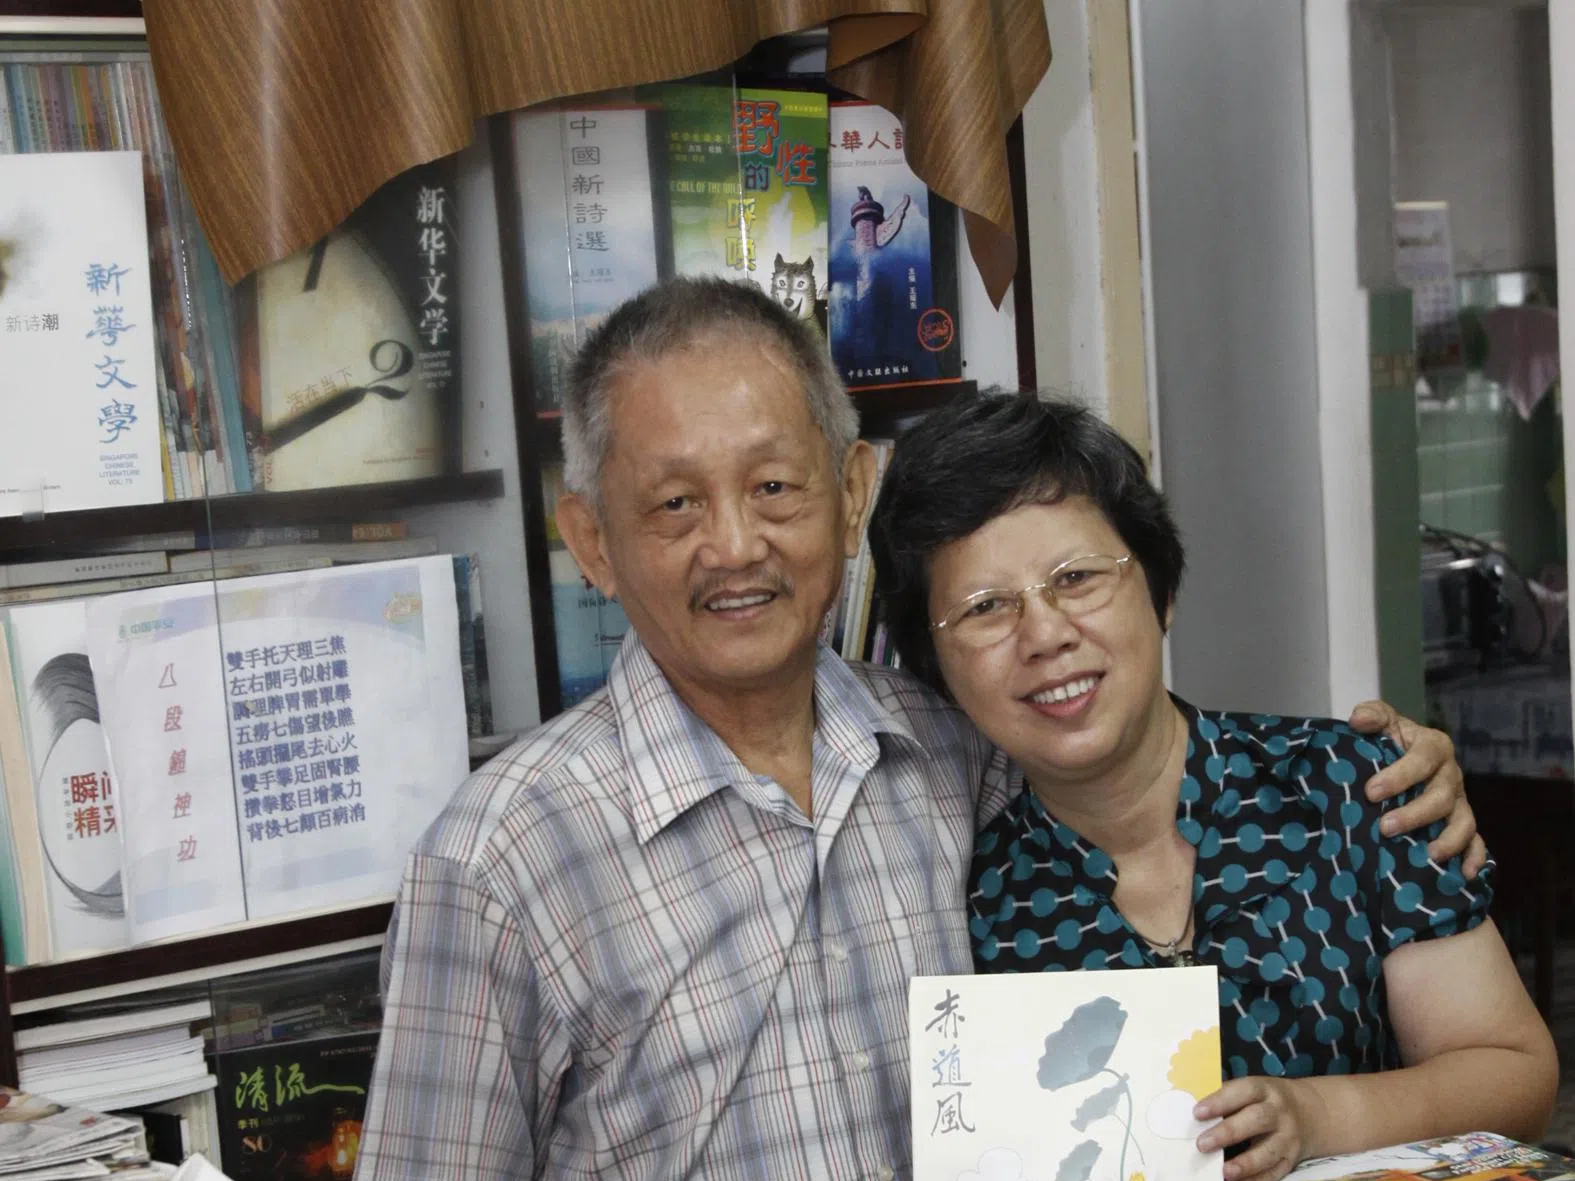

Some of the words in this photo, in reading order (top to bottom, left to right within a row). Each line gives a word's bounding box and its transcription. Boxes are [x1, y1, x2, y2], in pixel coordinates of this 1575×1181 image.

[570, 116, 610, 252] 中國新詩選
[829, 128, 903, 153] 華人
[416, 185, 450, 345] 新华文学
[6, 312, 59, 333] 新诗潮
[85, 263, 138, 444] 新華文學
[226, 634, 347, 673] 雙手托天理三焦
[235, 1062, 366, 1113] 清流
[925, 988, 976, 1137] 赤道風
